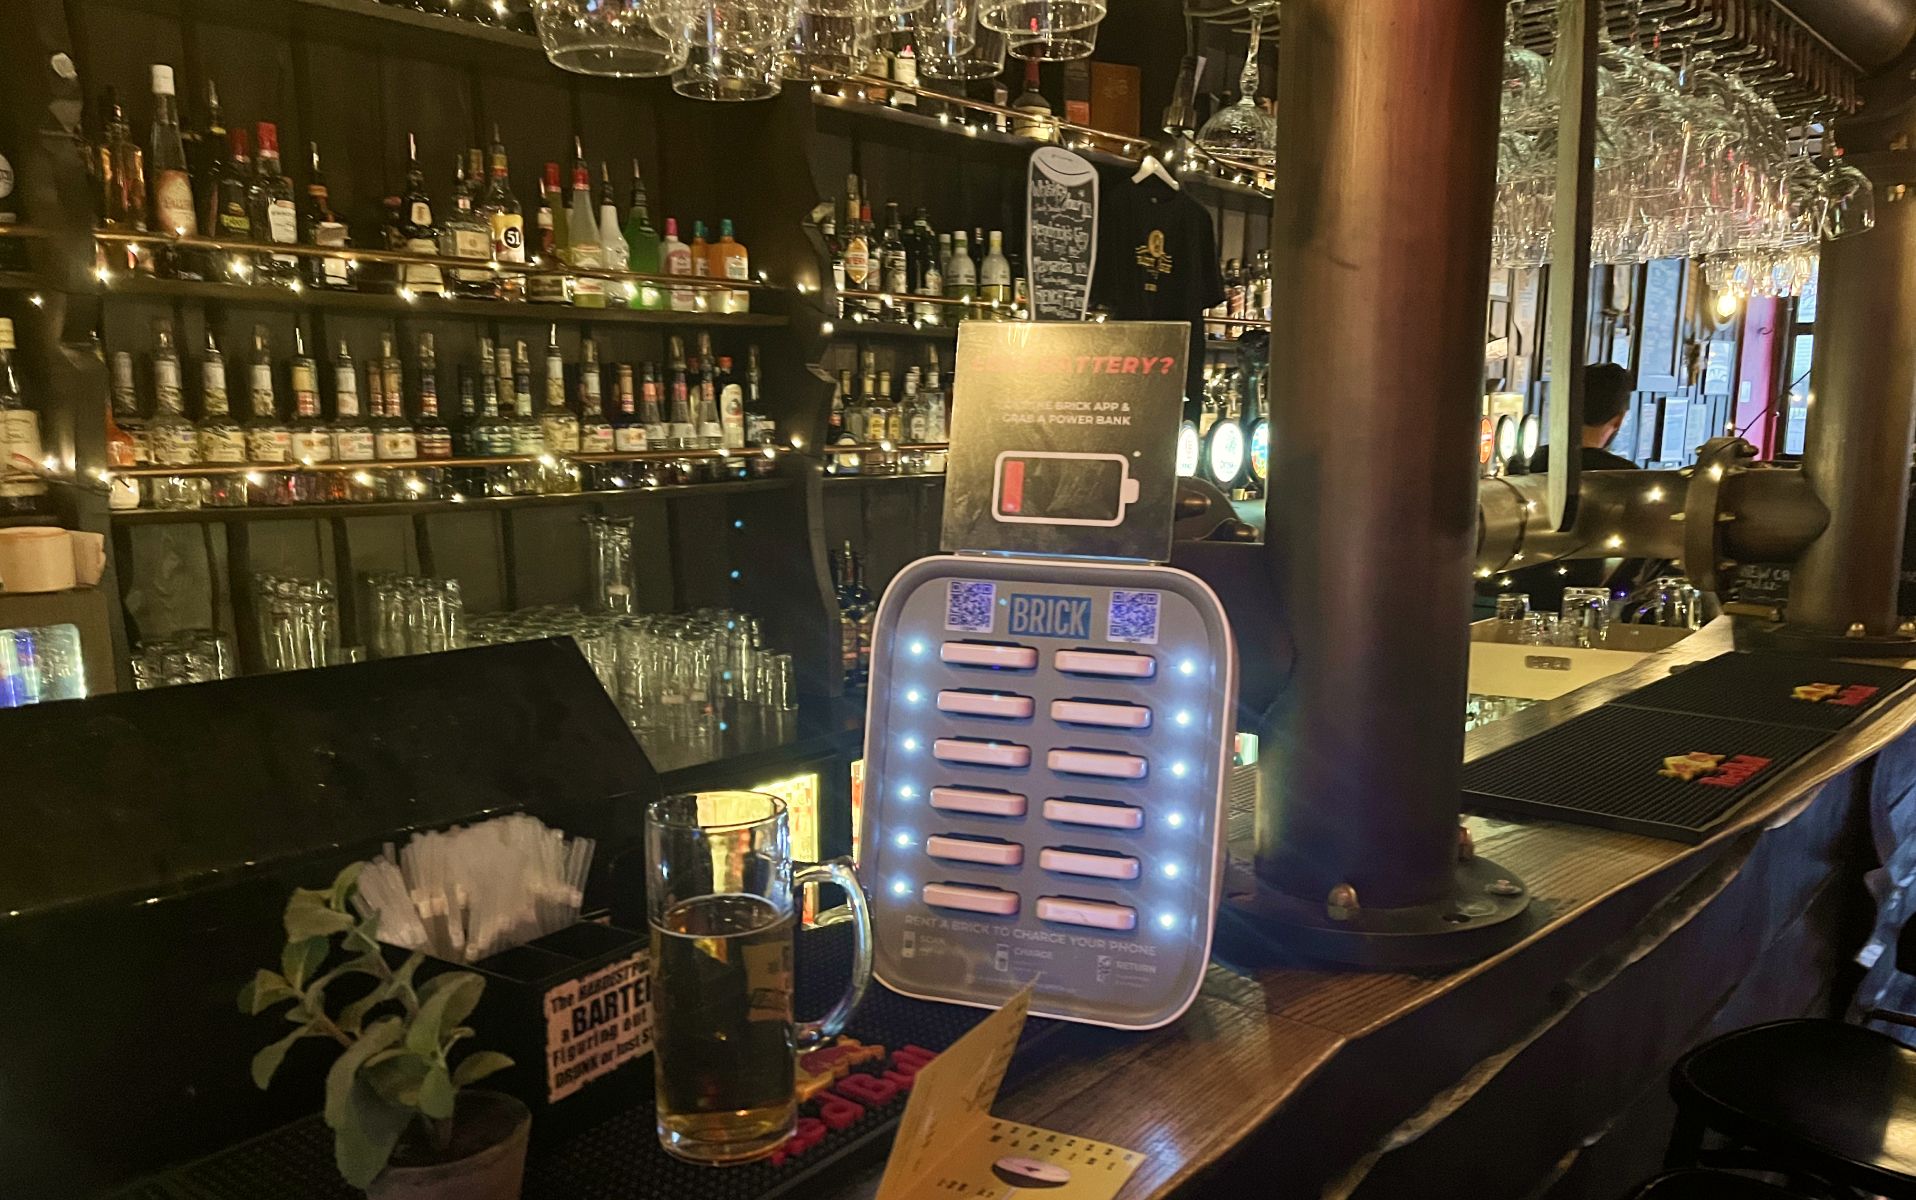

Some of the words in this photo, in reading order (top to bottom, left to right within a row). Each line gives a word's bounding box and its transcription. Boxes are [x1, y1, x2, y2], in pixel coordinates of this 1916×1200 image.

[507, 230, 520, 245] 51
[1055, 401, 1091, 411] BRICK
[1093, 401, 1119, 411] APP
[1121, 402, 1131, 412] &
[1002, 413, 1035, 423] GRAB
[1037, 414, 1046, 423] A
[1048, 414, 1094, 425] POWER
[1095, 415, 1132, 426] BANK
[1013, 597, 1089, 636] BRICK
[904, 914, 936, 928] RENT
[939, 918, 950, 931] A
[951, 919, 990, 935] BRICK
[992, 925, 1010, 937] TO
[1012, 928, 1066, 945] CHARGE
[1069, 936, 1106, 950] YOUR
[1109, 940, 1157, 957] PHONE
